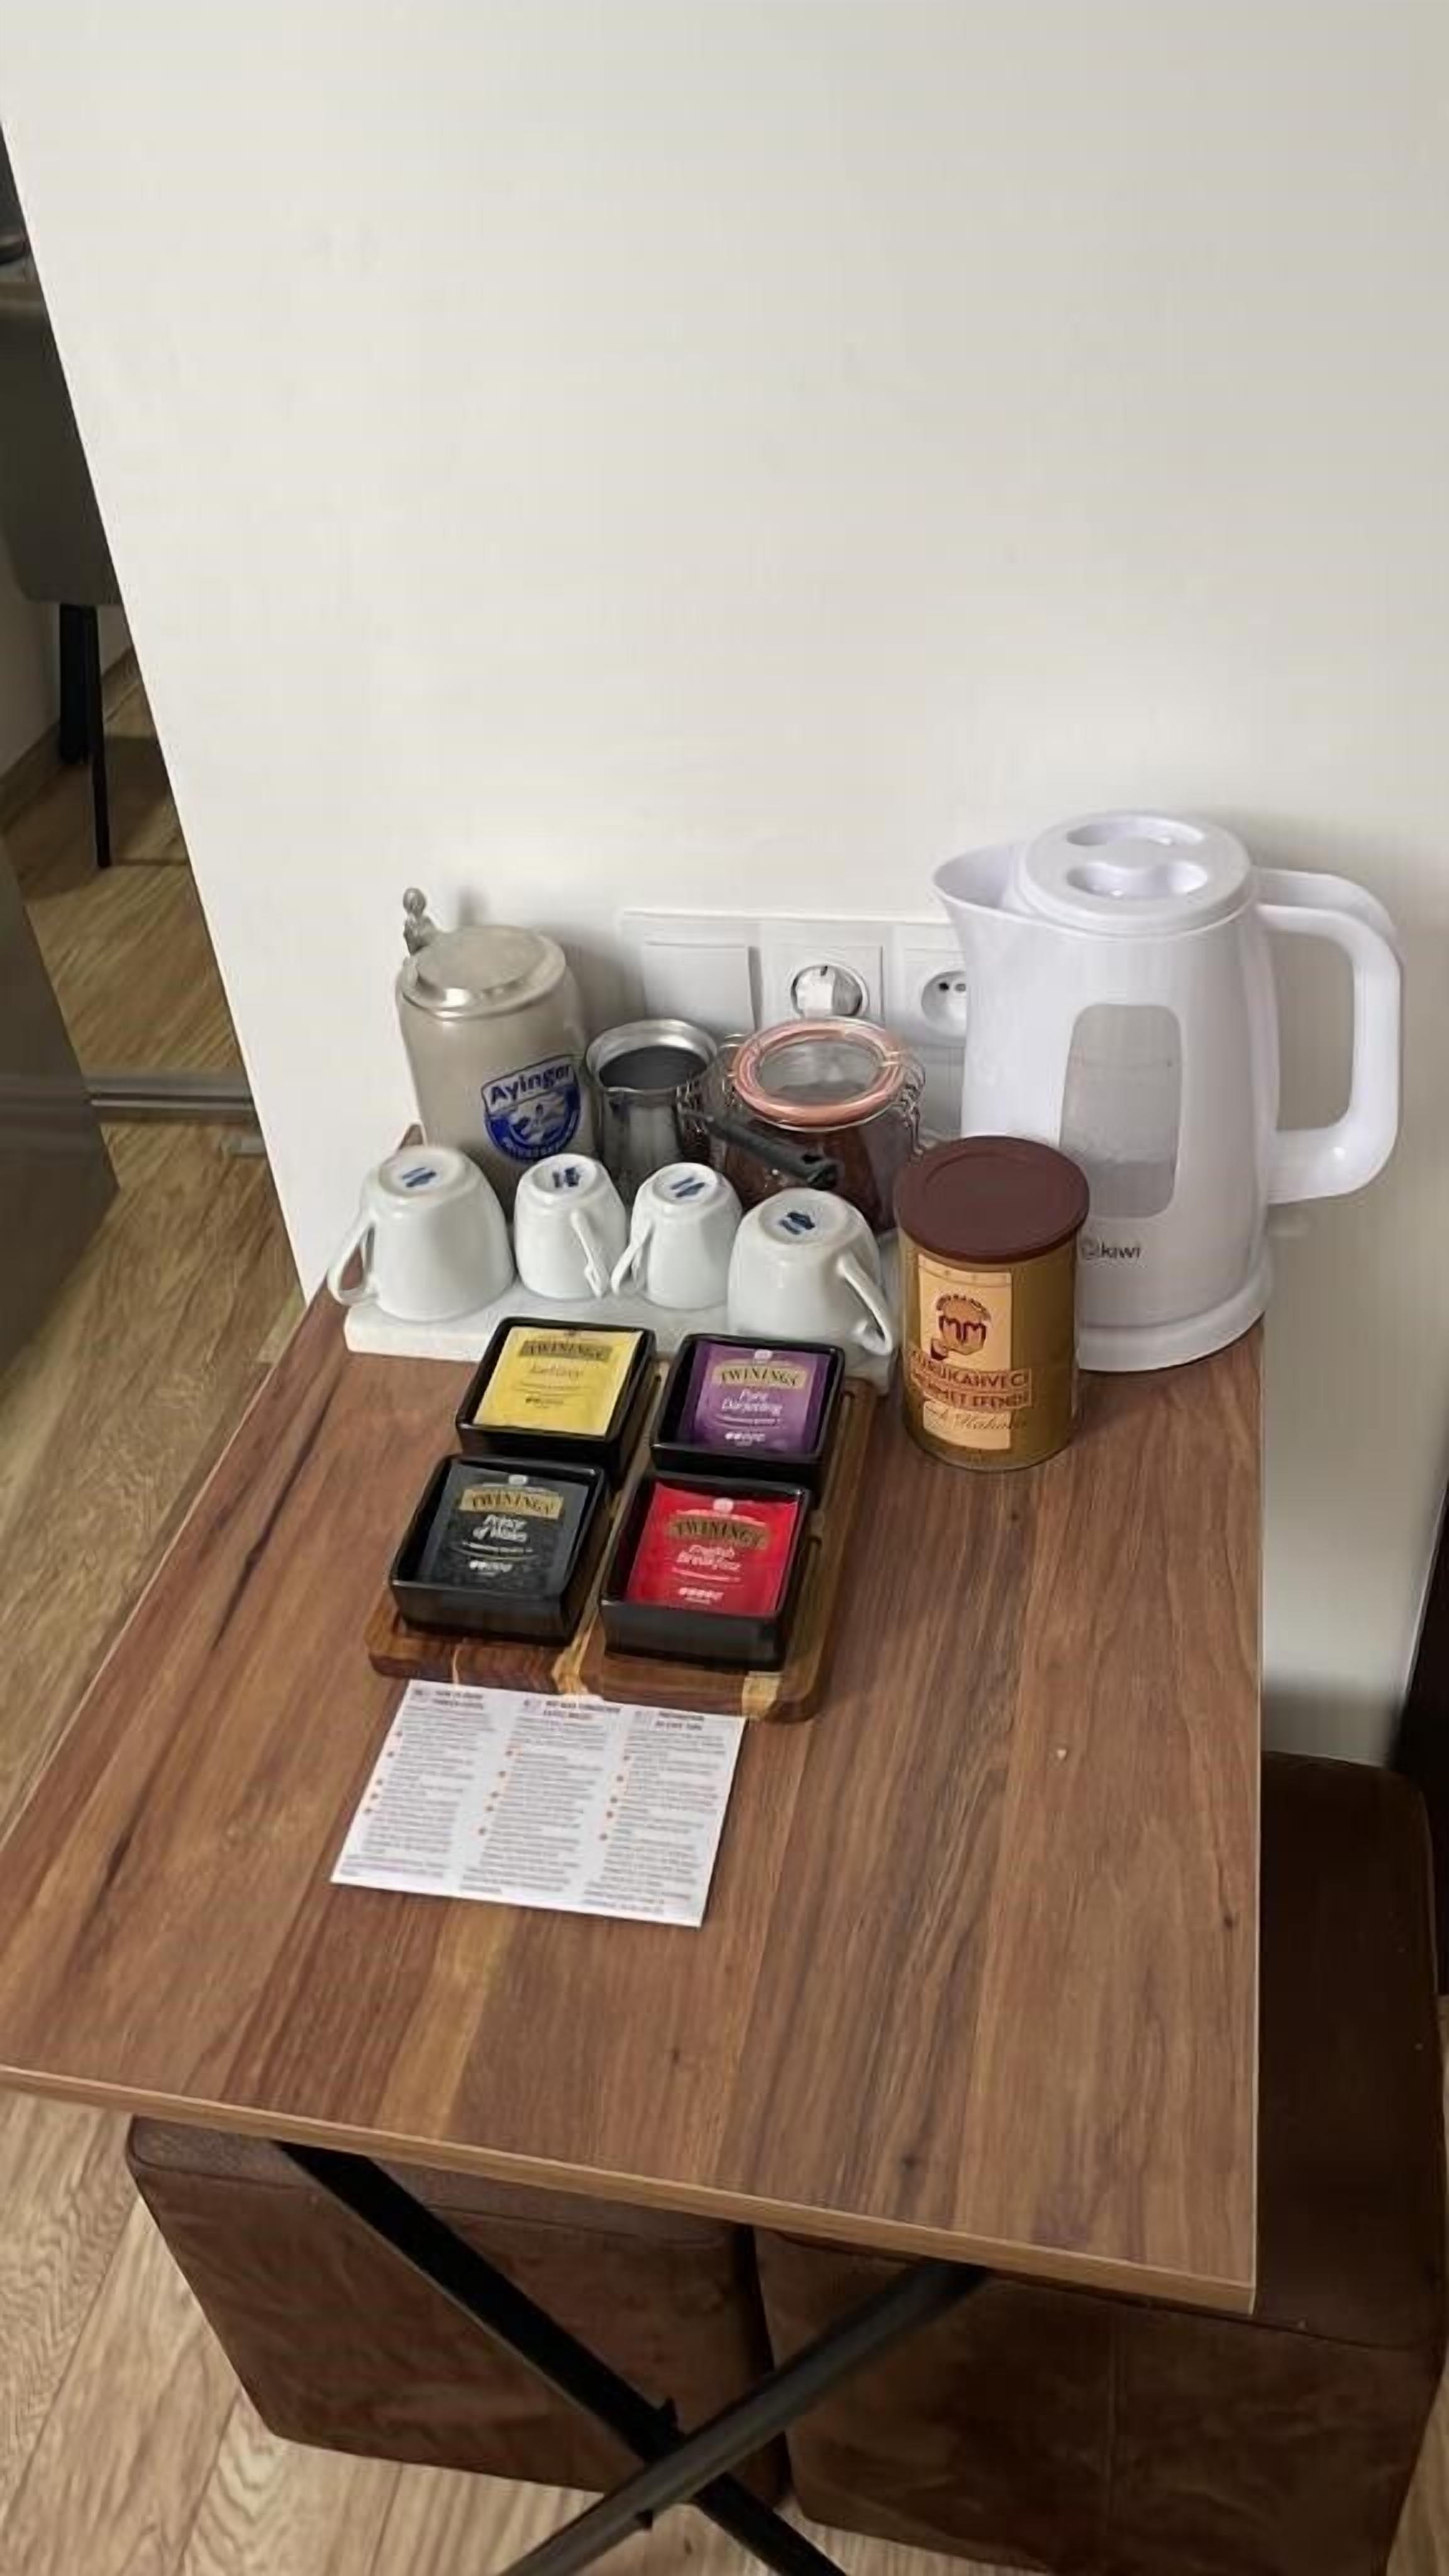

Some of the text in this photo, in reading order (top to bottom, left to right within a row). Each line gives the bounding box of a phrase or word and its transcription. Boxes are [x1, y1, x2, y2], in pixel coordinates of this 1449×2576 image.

[721, 1365, 798, 1386] TWININGS
[471, 1492, 554, 1513] TWININGS
[675, 1520, 765, 1547] TWININGS
